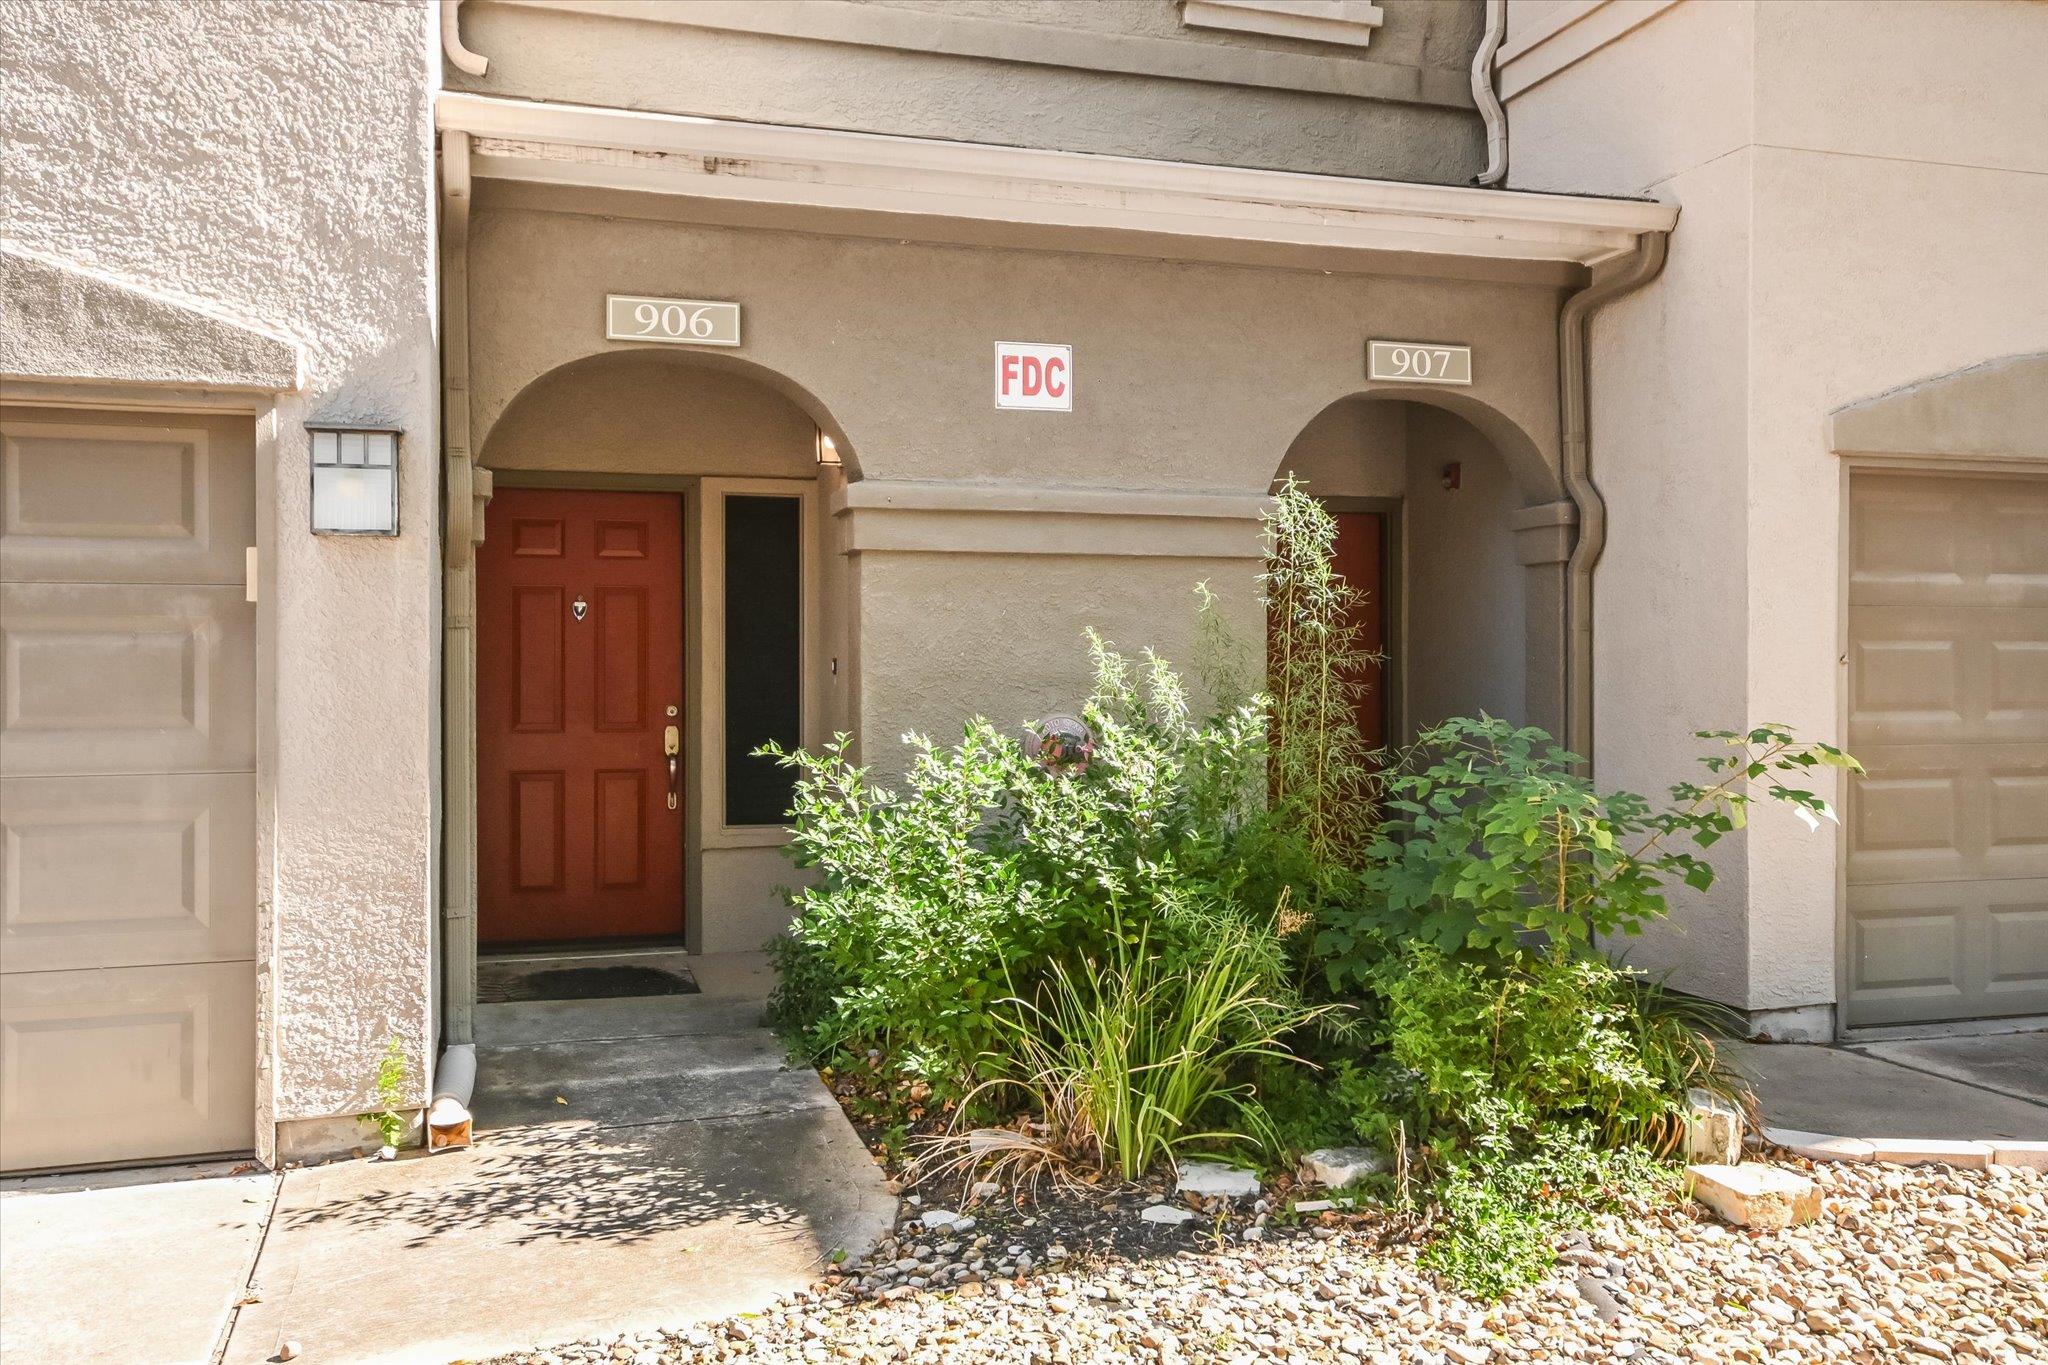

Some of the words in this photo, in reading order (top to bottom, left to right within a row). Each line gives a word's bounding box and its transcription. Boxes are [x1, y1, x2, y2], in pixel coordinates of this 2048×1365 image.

[634, 303, 714, 338] 906
[1002, 355, 1066, 398] FDC
[1391, 348, 1451, 377] 907
